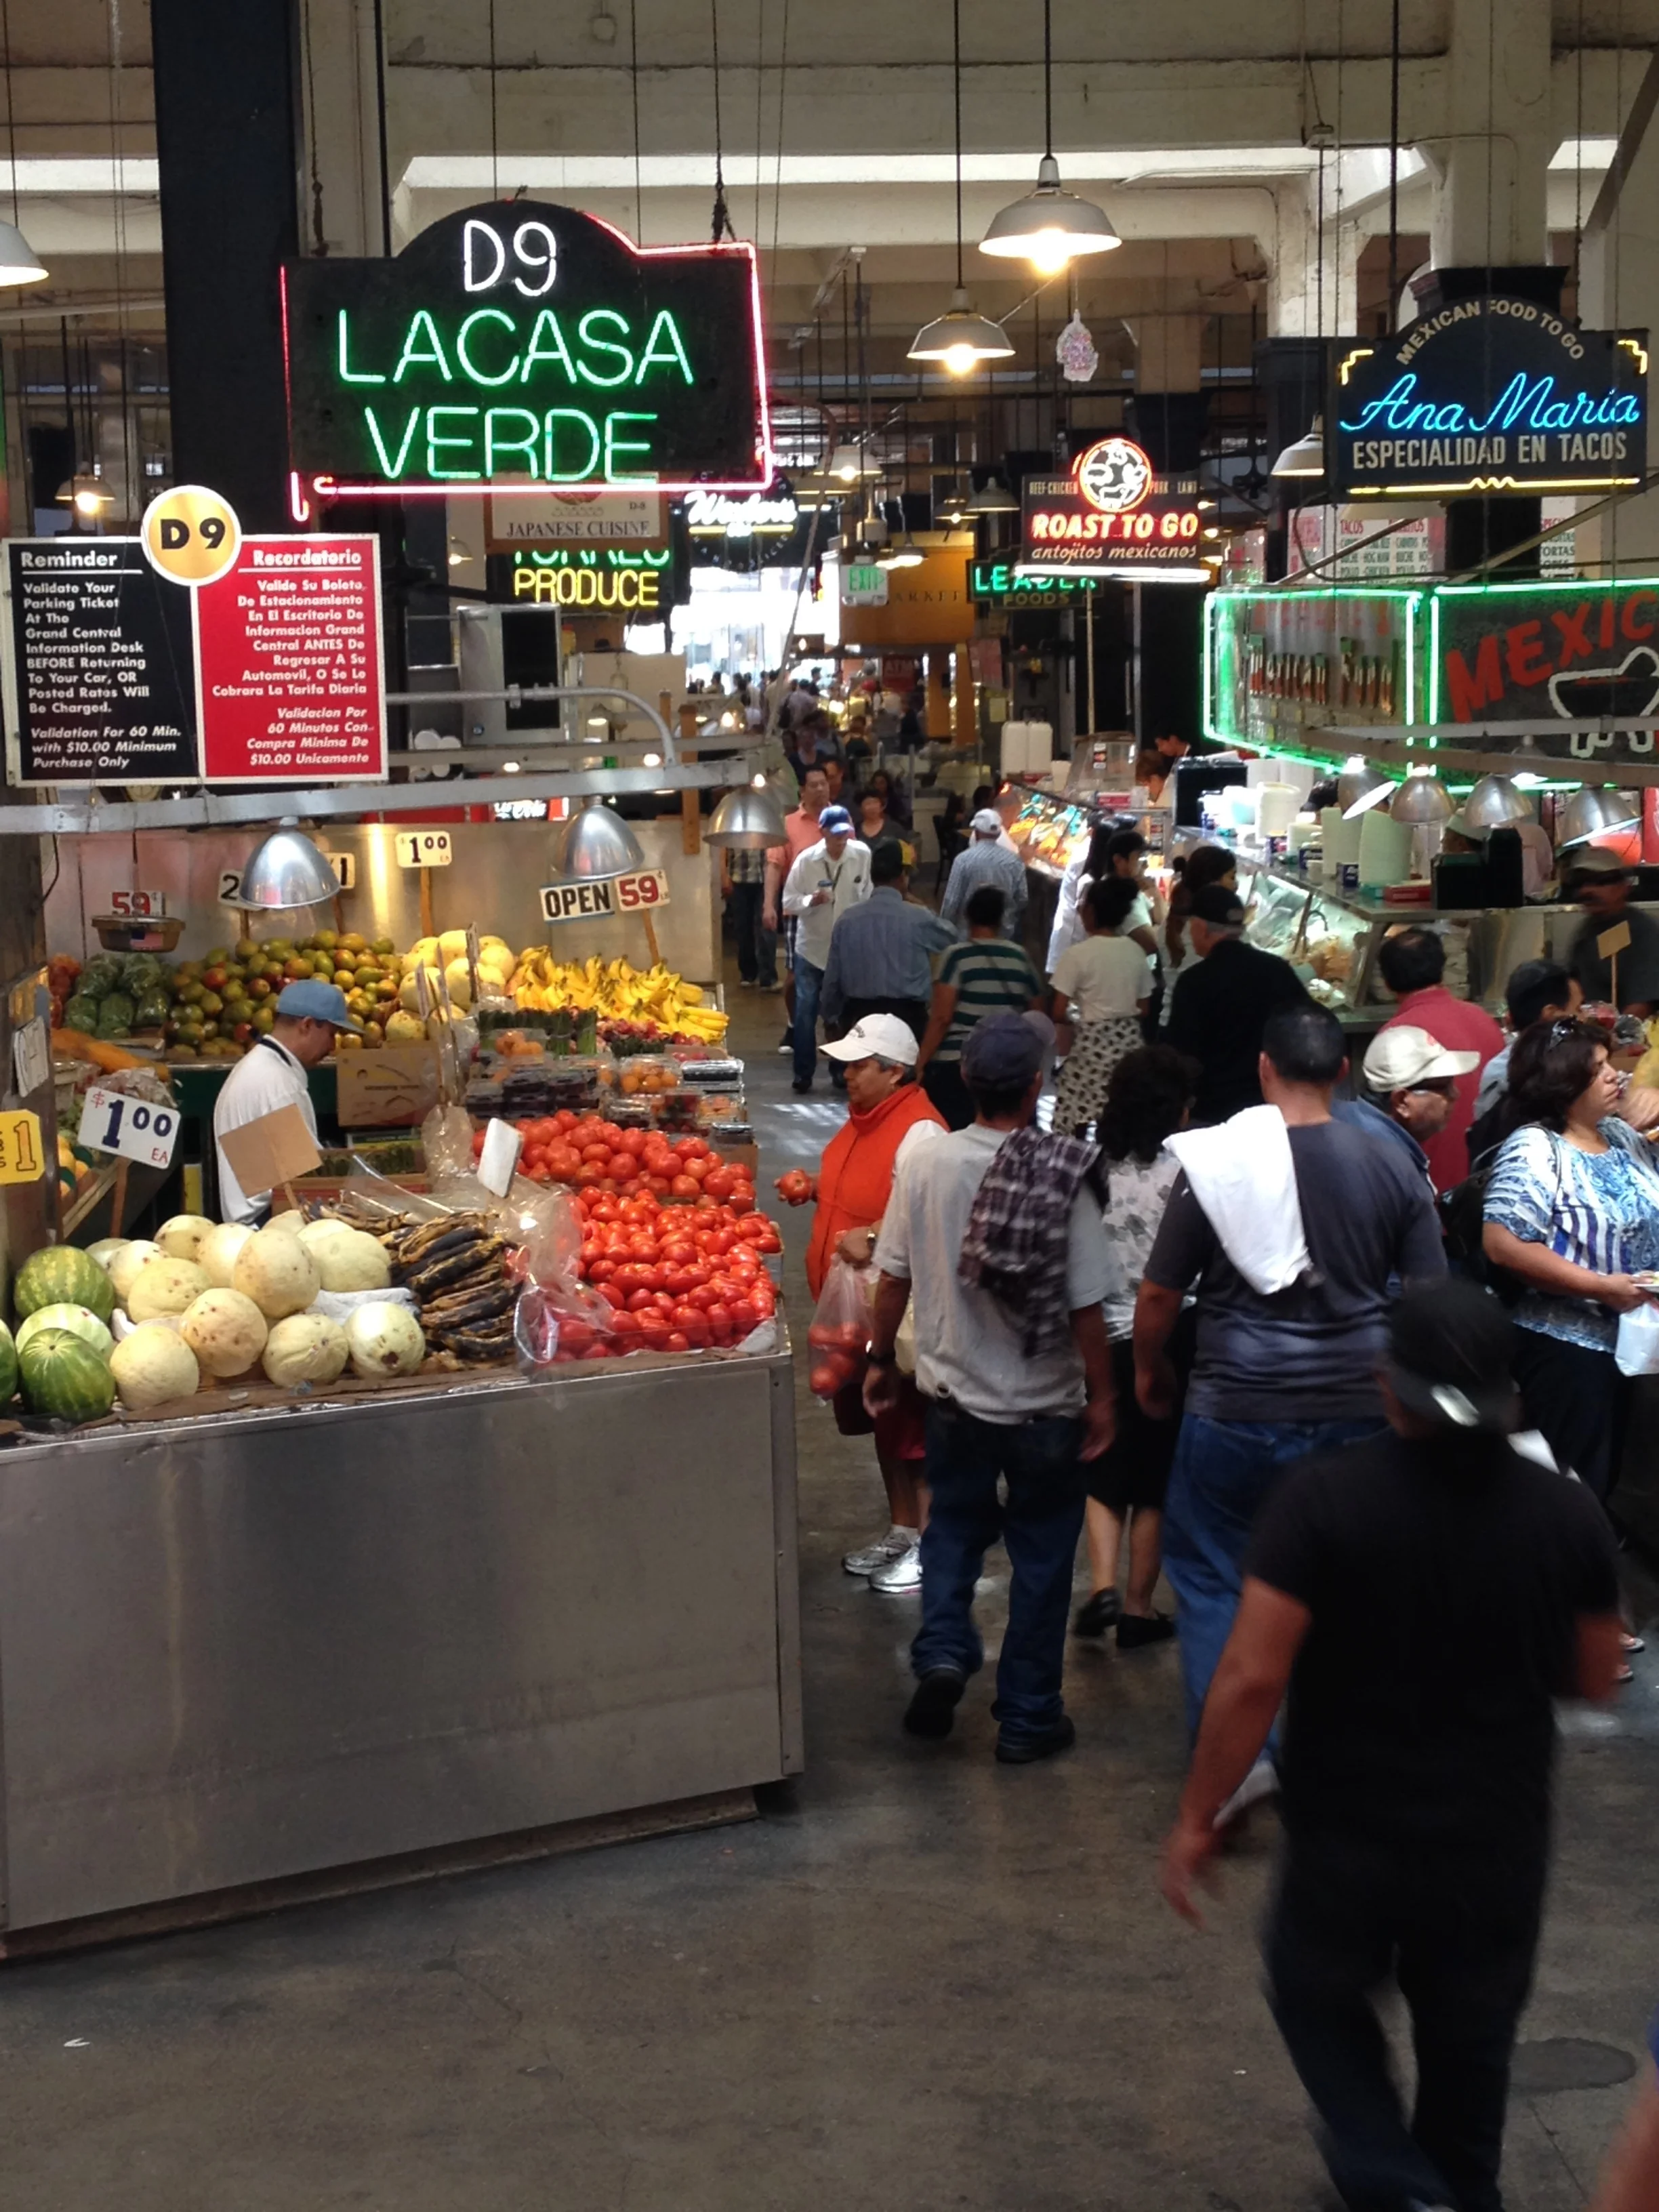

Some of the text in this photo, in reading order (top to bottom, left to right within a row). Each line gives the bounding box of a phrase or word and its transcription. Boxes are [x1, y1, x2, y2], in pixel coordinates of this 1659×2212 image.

[464, 220, 557, 296] D9
[1396, 300, 1584, 365] MEXICAN FOOD TO GO
[1339, 373, 1465, 432] Ana
[365, 407, 658, 485] VERDE
[1353, 432, 1626, 469] ESPECIALIDAD EN TACOS
[507, 520, 649, 537] JAPANESE CUISINE
[1031, 512, 1198, 539] ROAST TO GO
[21, 551, 117, 567] Reminder
[253, 548, 361, 566] Recordatorio
[1032, 543, 1197, 565] antojitos mexicanos
[23, 582, 115, 594] Validate Your
[302, 580, 317, 590] Su
[514, 568, 659, 607] PRODUCE
[23, 598, 119, 611] Parking Ticket
[238, 594, 363, 607] De Estacionamiento
[1004, 592, 1069, 605] FOODS
[26, 613, 69, 623] At The
[249, 609, 364, 621] En El Escritorio De
[26, 627, 121, 638] Grand Central
[325, 623, 365, 634] Grand
[26, 641, 144, 654] Information Desk
[253, 638, 365, 651] Central ANTES De
[26, 657, 146, 670] BEFORE Returning
[274, 653, 365, 668] Regresar A Su
[1446, 590, 1658, 724] MEXIC
[28, 672, 137, 684] To Your Car, OR
[316, 669, 327, 680] O
[332, 669, 347, 680] Se
[352, 668, 366, 680] Le
[28, 687, 150, 699] Posted Rates Will
[212, 683, 367, 697] Cobrara La Tarifa Diaria
[29, 701, 112, 715] Be Charged.
[277, 706, 367, 719] Validacion Por
[31, 725, 182, 739] Validation For 60 Min.
[268, 723, 284, 734] 60
[289, 722, 339, 733] Minutos
[32, 741, 177, 753] with $10.00 Minimum
[247, 738, 295, 750] Compra
[352, 736, 369, 747] De
[33, 756, 130, 769] Purchase Only
[251, 752, 369, 765] $10.00 Unicamente
[544, 883, 611, 918] OPEN
[151, 1147, 169, 1163] EA
